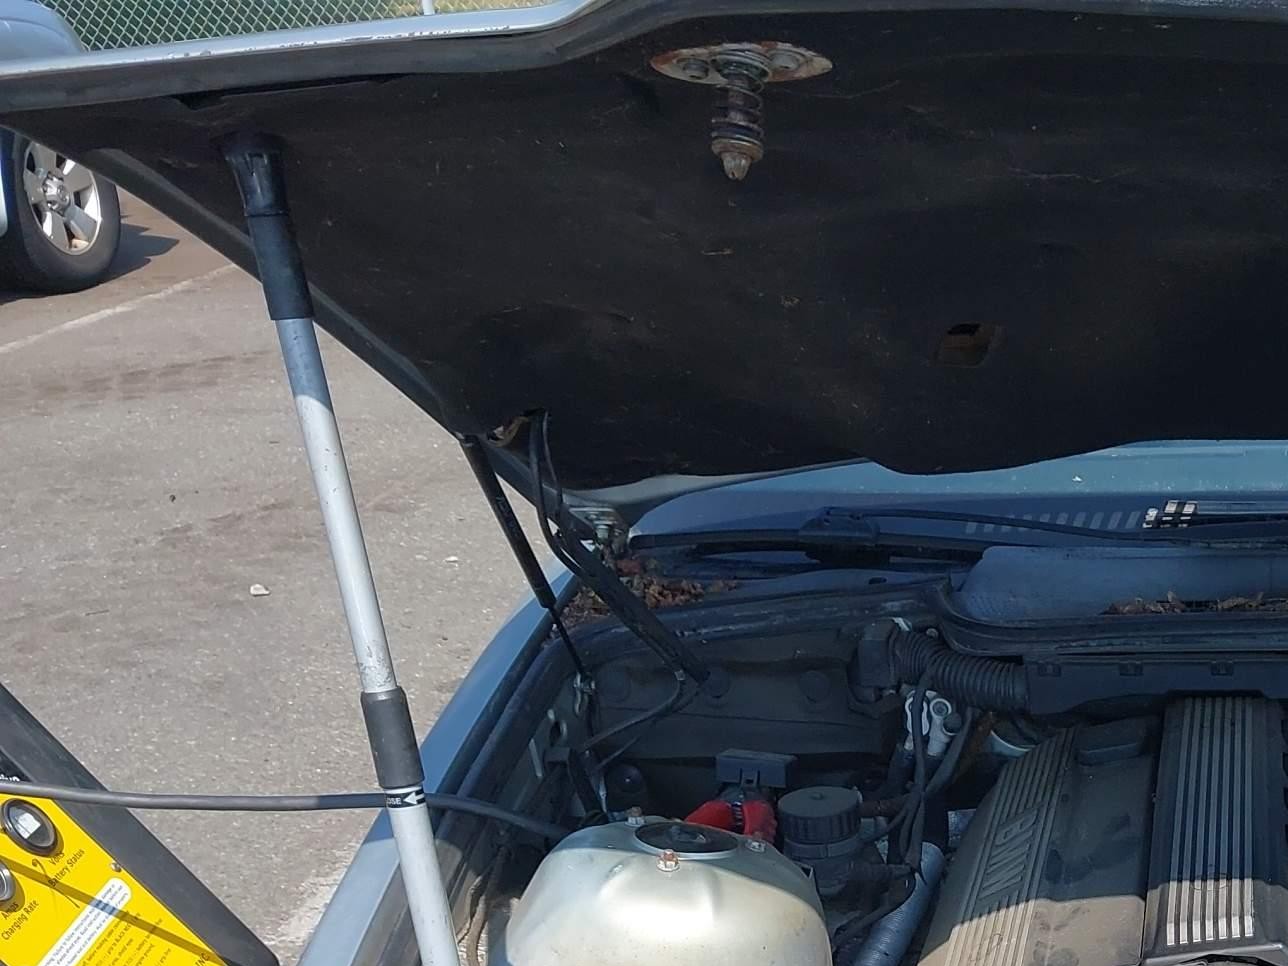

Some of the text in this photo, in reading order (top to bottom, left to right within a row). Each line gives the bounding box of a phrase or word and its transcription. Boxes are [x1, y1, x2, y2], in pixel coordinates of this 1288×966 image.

[47, 846, 86, 888] Battery Status
[0, 898, 40, 941] Charging Rate
